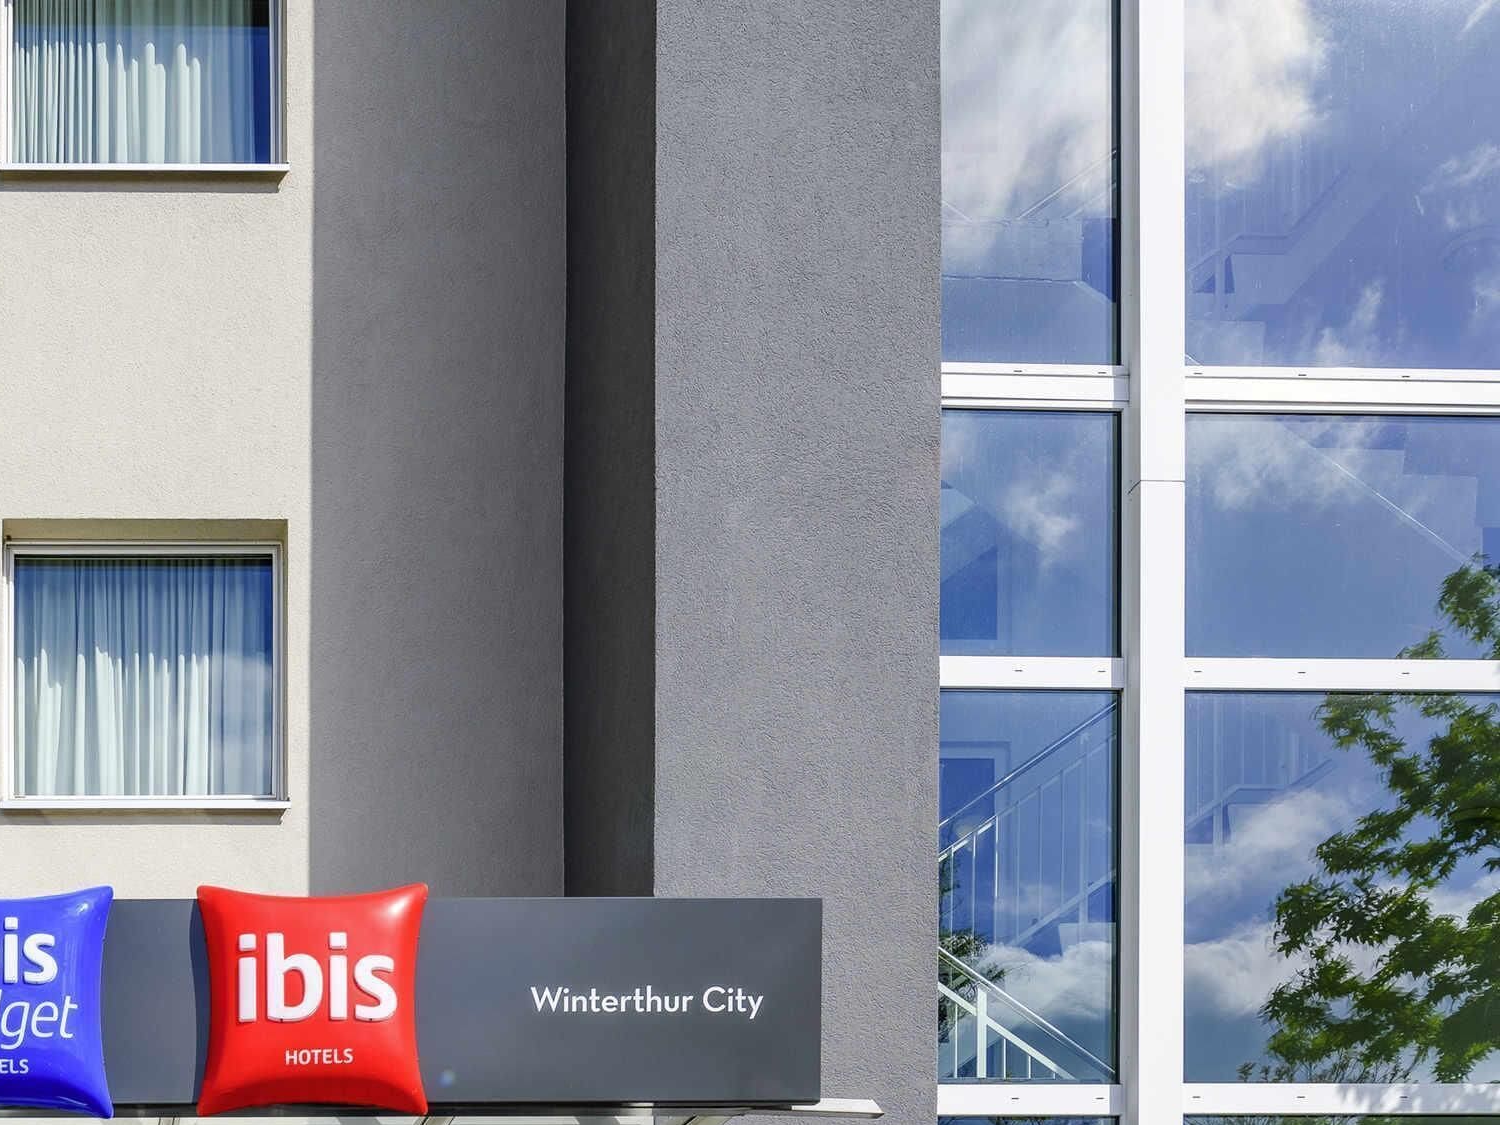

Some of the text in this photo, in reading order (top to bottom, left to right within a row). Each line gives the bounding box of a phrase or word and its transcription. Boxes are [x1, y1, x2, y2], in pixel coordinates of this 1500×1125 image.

[238, 932, 398, 1022] ibis
[531, 985, 764, 1019] Winterthur City
[285, 1048, 354, 1065] HOTELS
